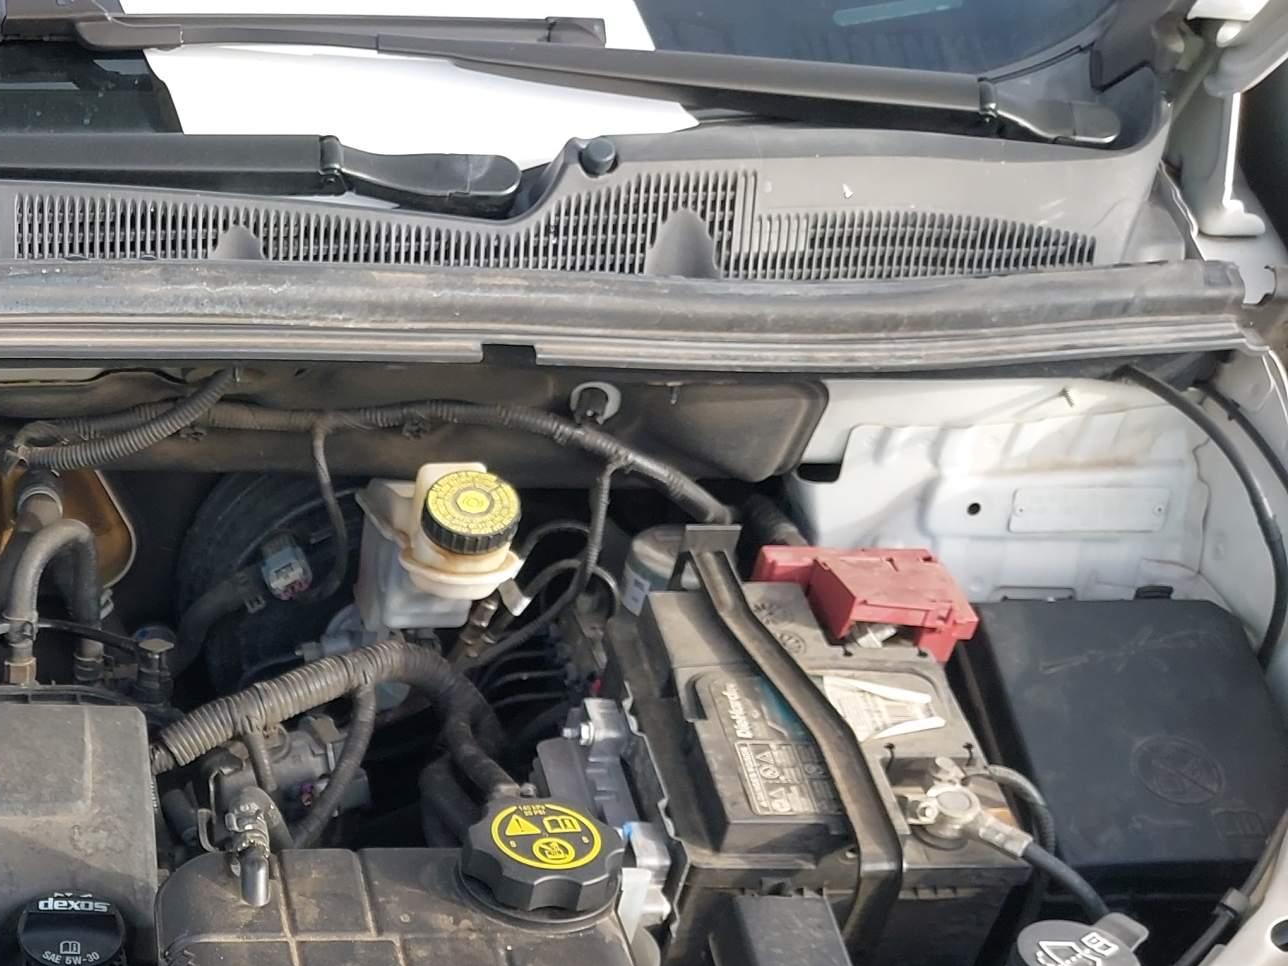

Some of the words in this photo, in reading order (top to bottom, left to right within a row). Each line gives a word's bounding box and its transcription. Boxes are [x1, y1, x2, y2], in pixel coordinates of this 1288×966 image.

[38, 897, 111, 913] dexos
[42, 950, 63, 964] SAE
[64, 951, 100, 966] 5W-30
